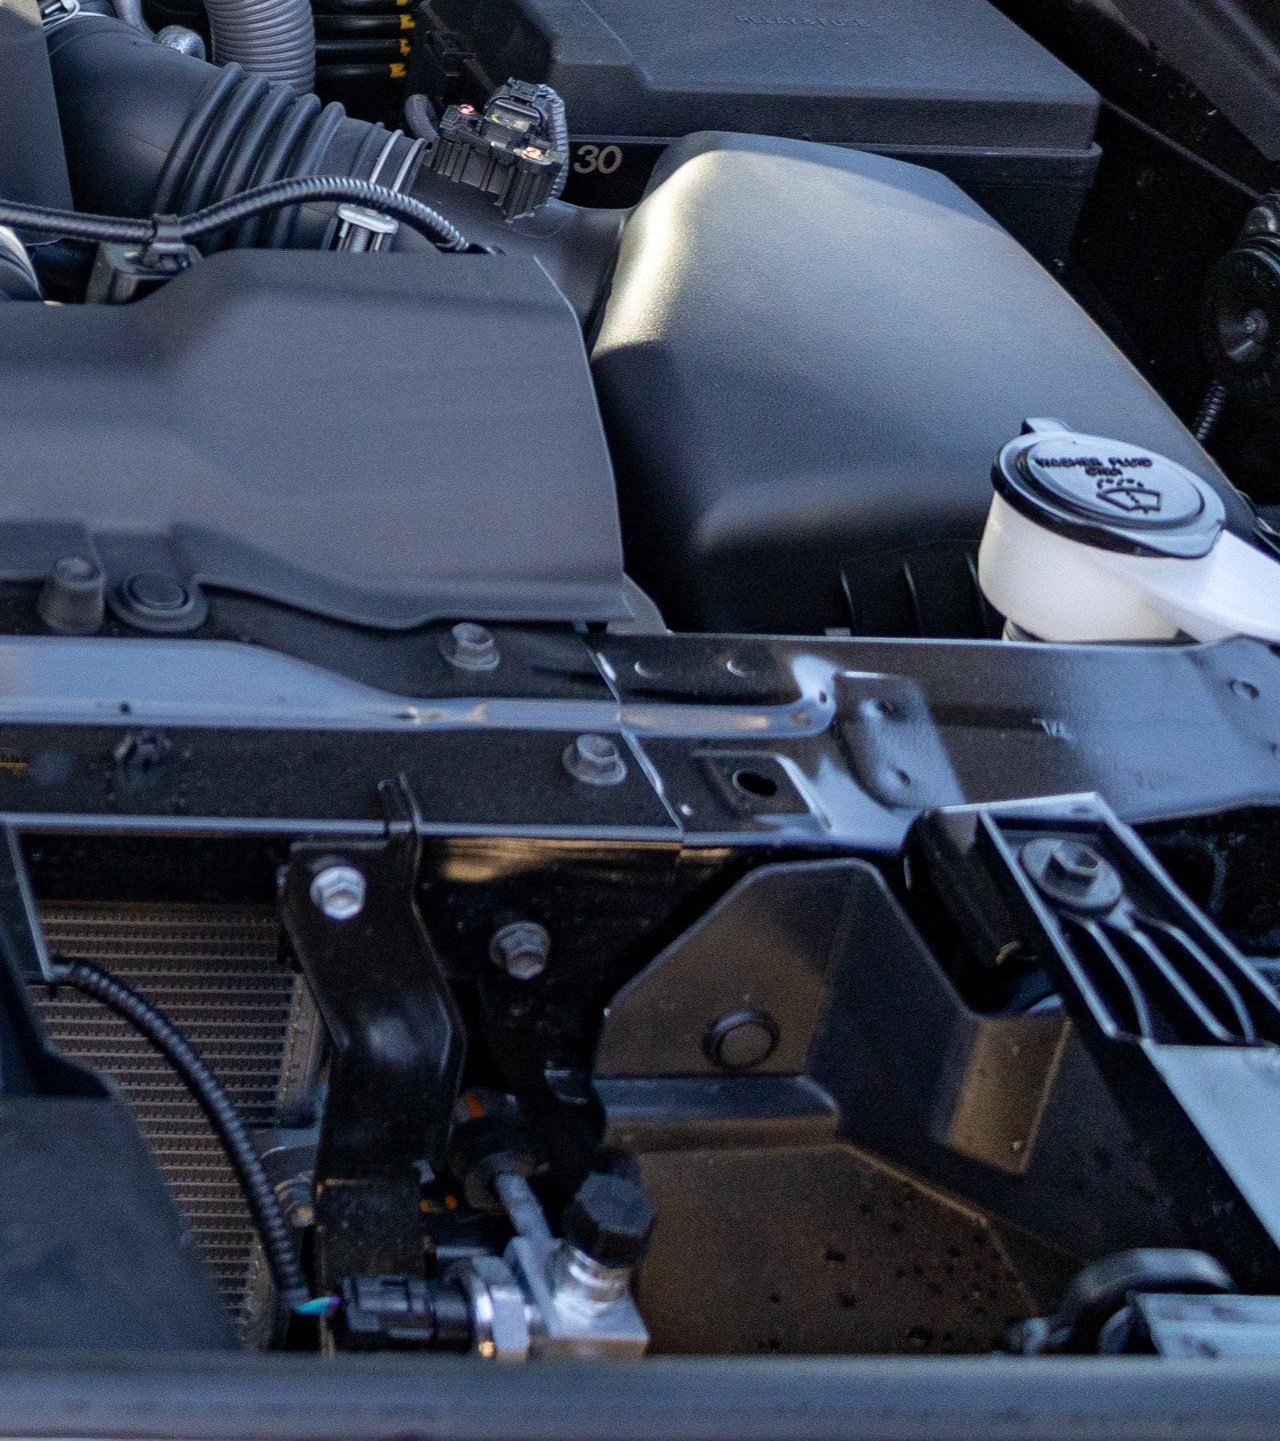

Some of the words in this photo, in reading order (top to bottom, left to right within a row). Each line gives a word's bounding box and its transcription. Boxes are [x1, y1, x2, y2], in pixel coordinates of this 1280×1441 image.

[572, 144, 624, 175] 30
[1034, 457, 1102, 468] WASHER
[1108, 457, 1153, 468] FLUID
